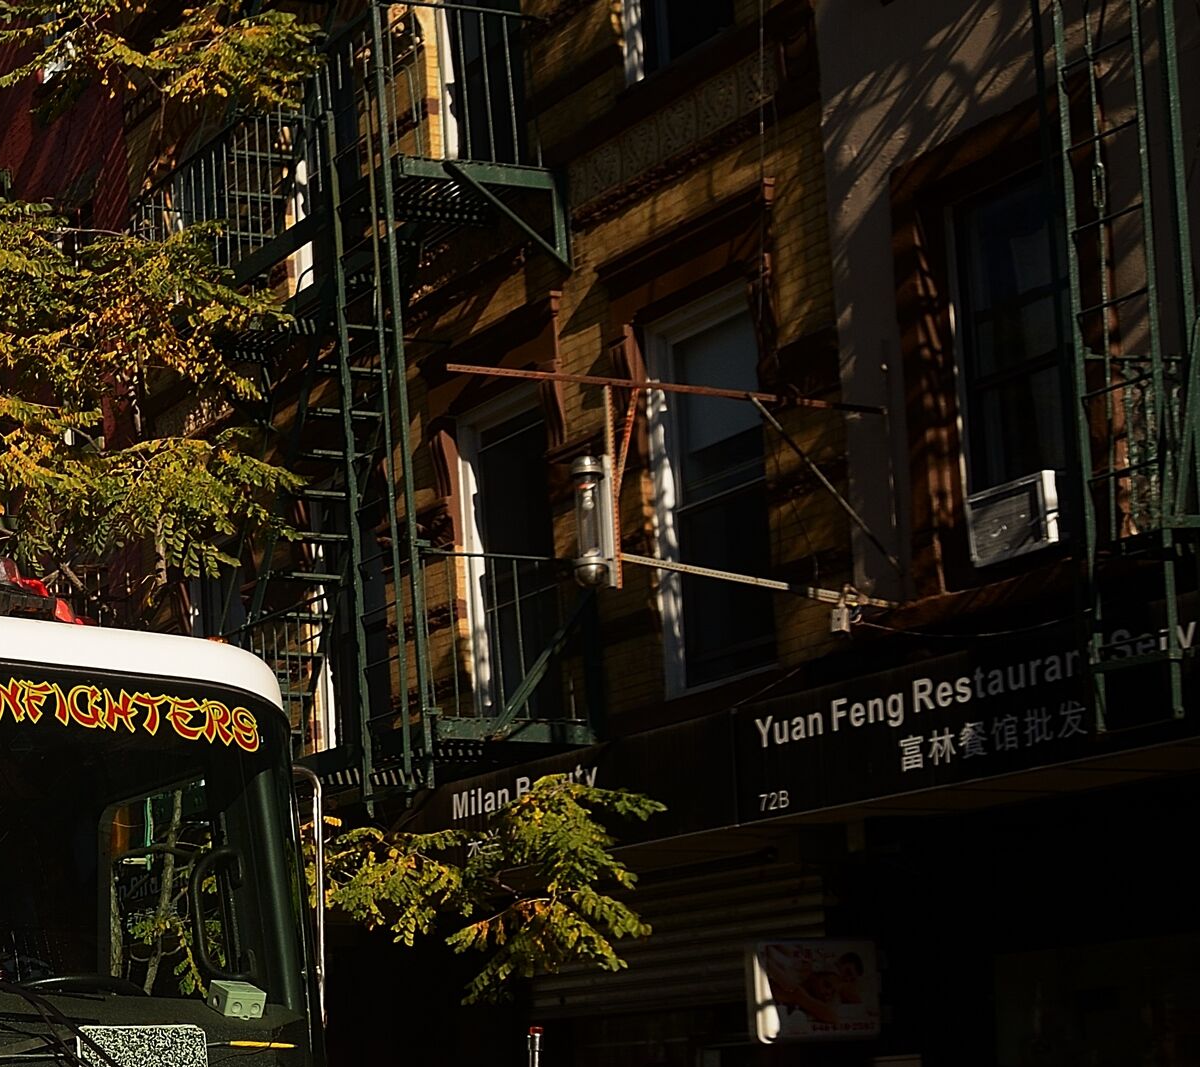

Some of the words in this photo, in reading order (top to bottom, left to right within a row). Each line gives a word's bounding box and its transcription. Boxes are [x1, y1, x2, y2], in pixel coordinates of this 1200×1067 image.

[755, 711, 823, 749] Yuan
[831, 690, 905, 732] Feng
[900, 702, 1089, 772] 富林餐馆批发
[452, 787, 510, 820] Milan
[758, 790, 790, 812] 72B
